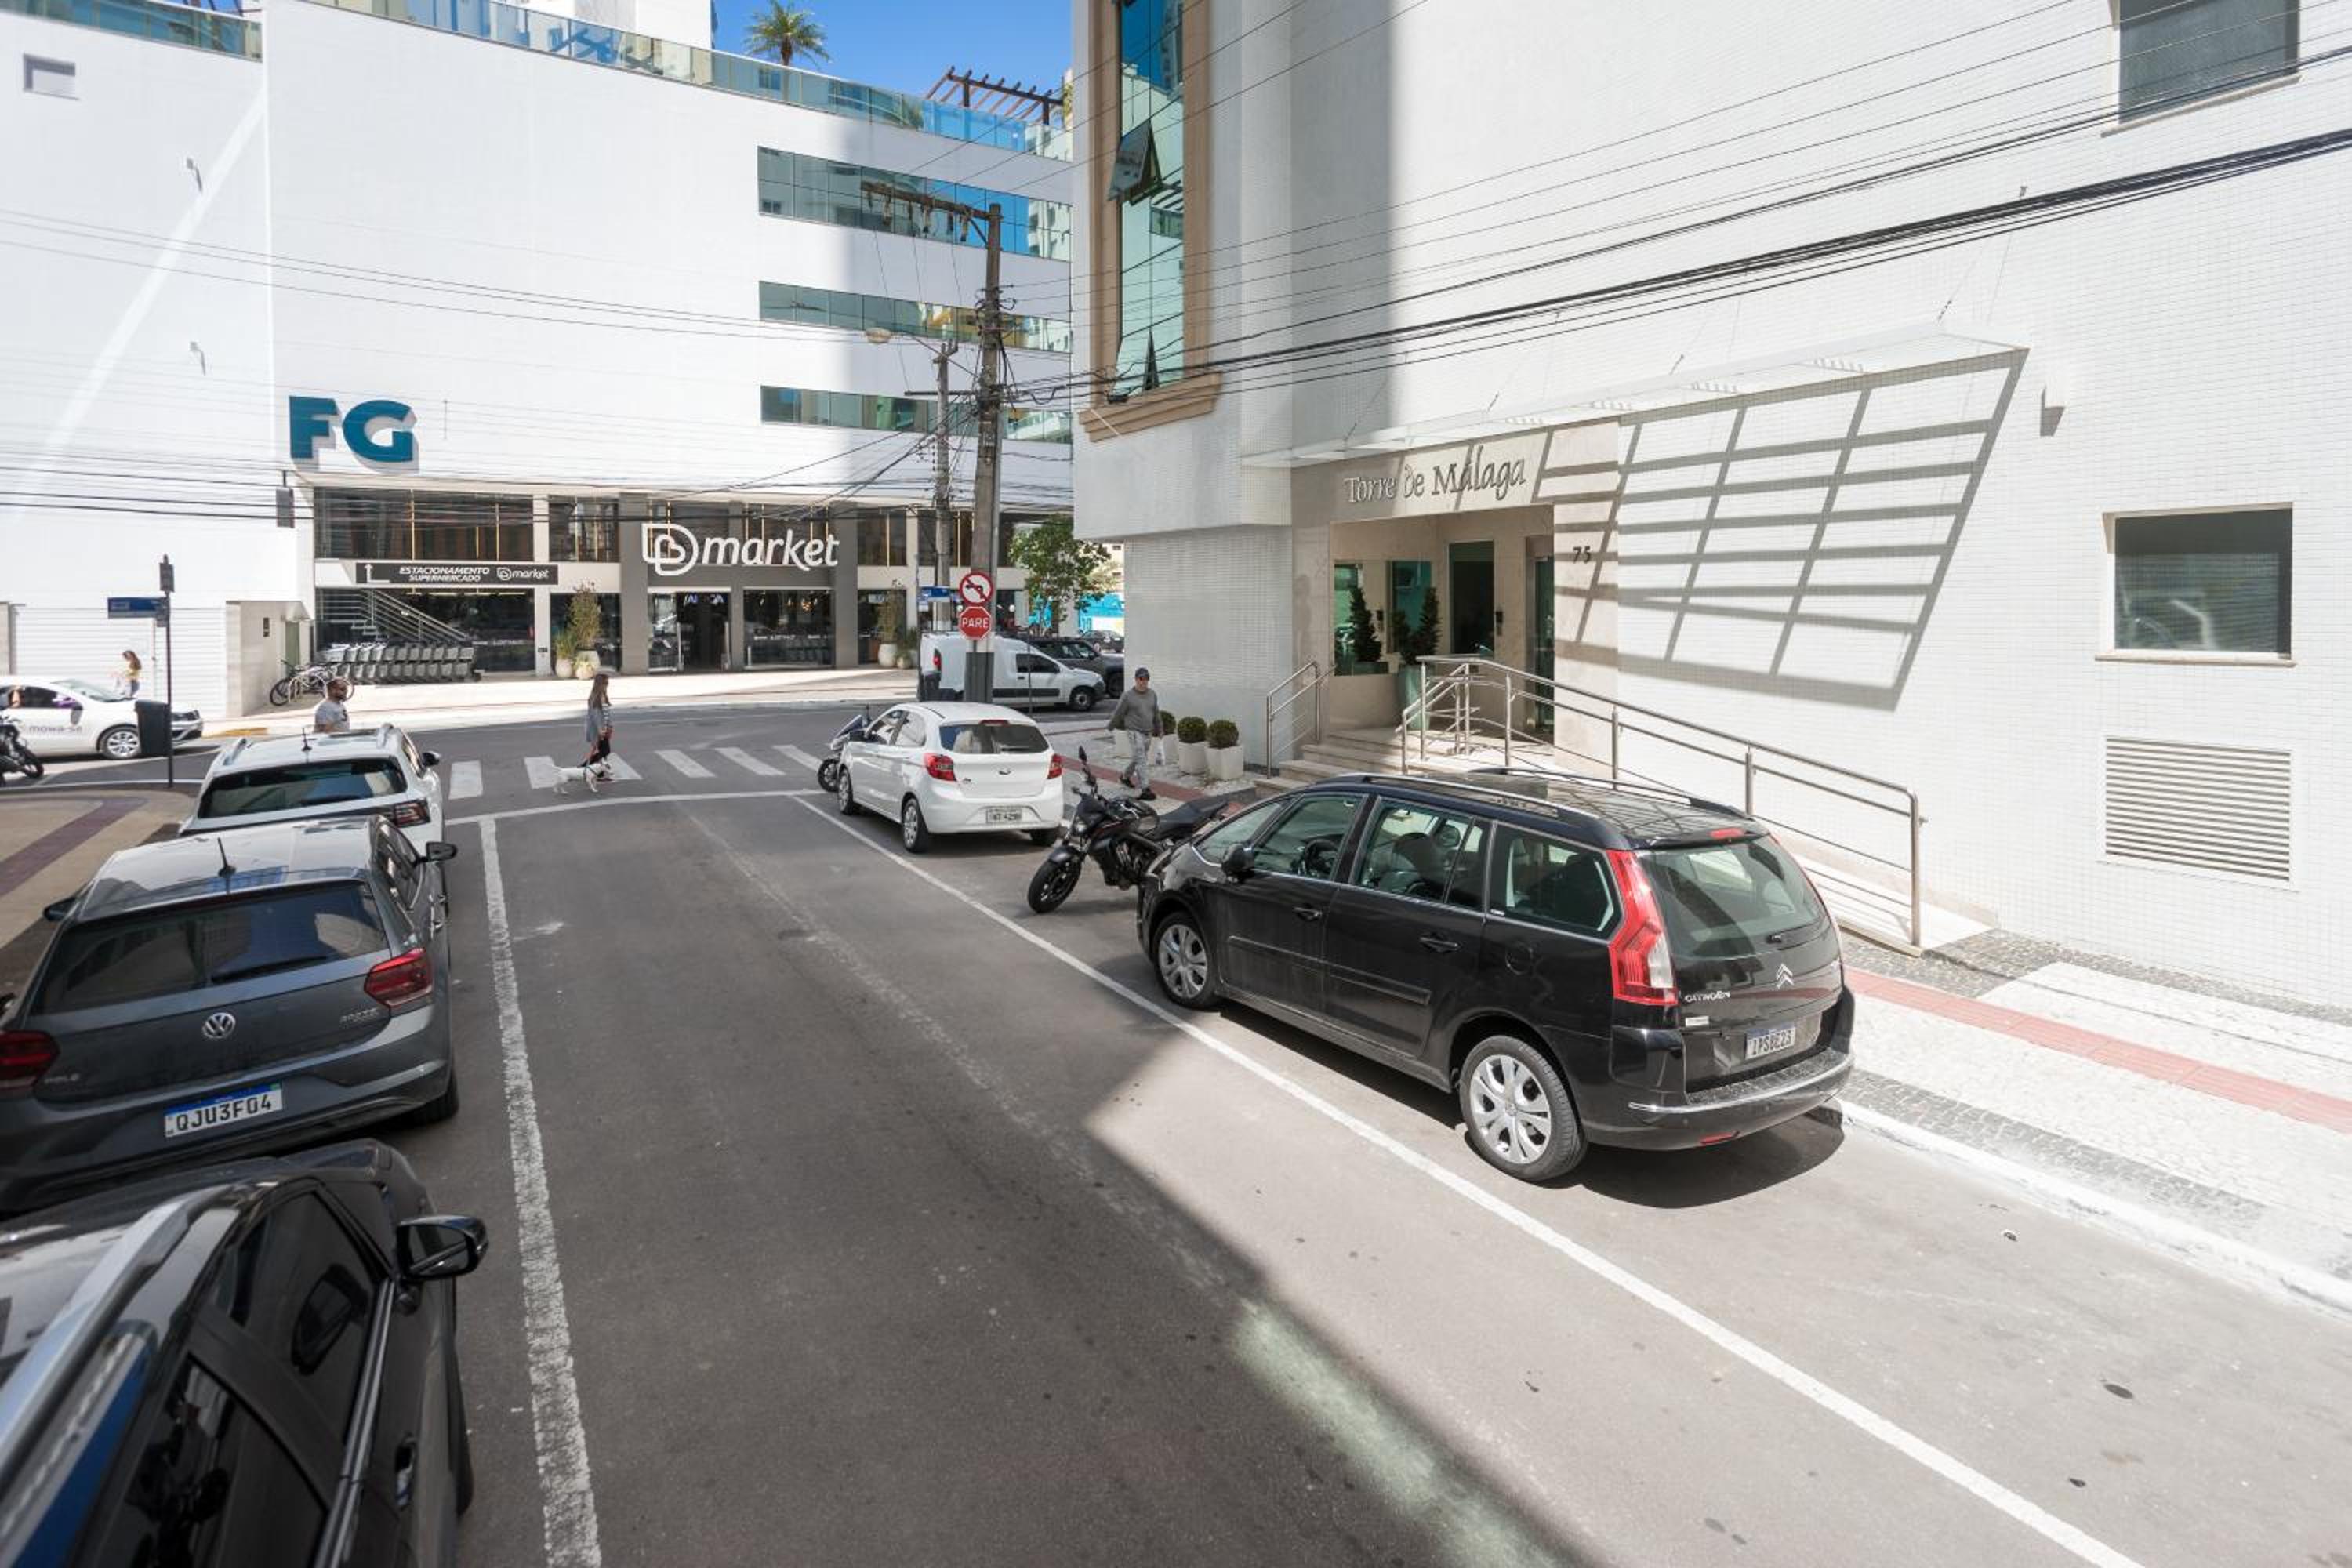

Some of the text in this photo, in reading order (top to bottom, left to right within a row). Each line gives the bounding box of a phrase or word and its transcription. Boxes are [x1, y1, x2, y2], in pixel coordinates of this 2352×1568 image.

[289, 395, 414, 463] FG
[1344, 445, 1526, 503] Torre de Málaga
[702, 528, 840, 572] market
[1573, 545, 1591, 564] 75
[399, 566, 490, 575] ESTACIONAMENTO
[512, 568, 550, 579] market
[962, 617, 989, 628] PARE
[176, 1094, 272, 1131] QJU3F04
